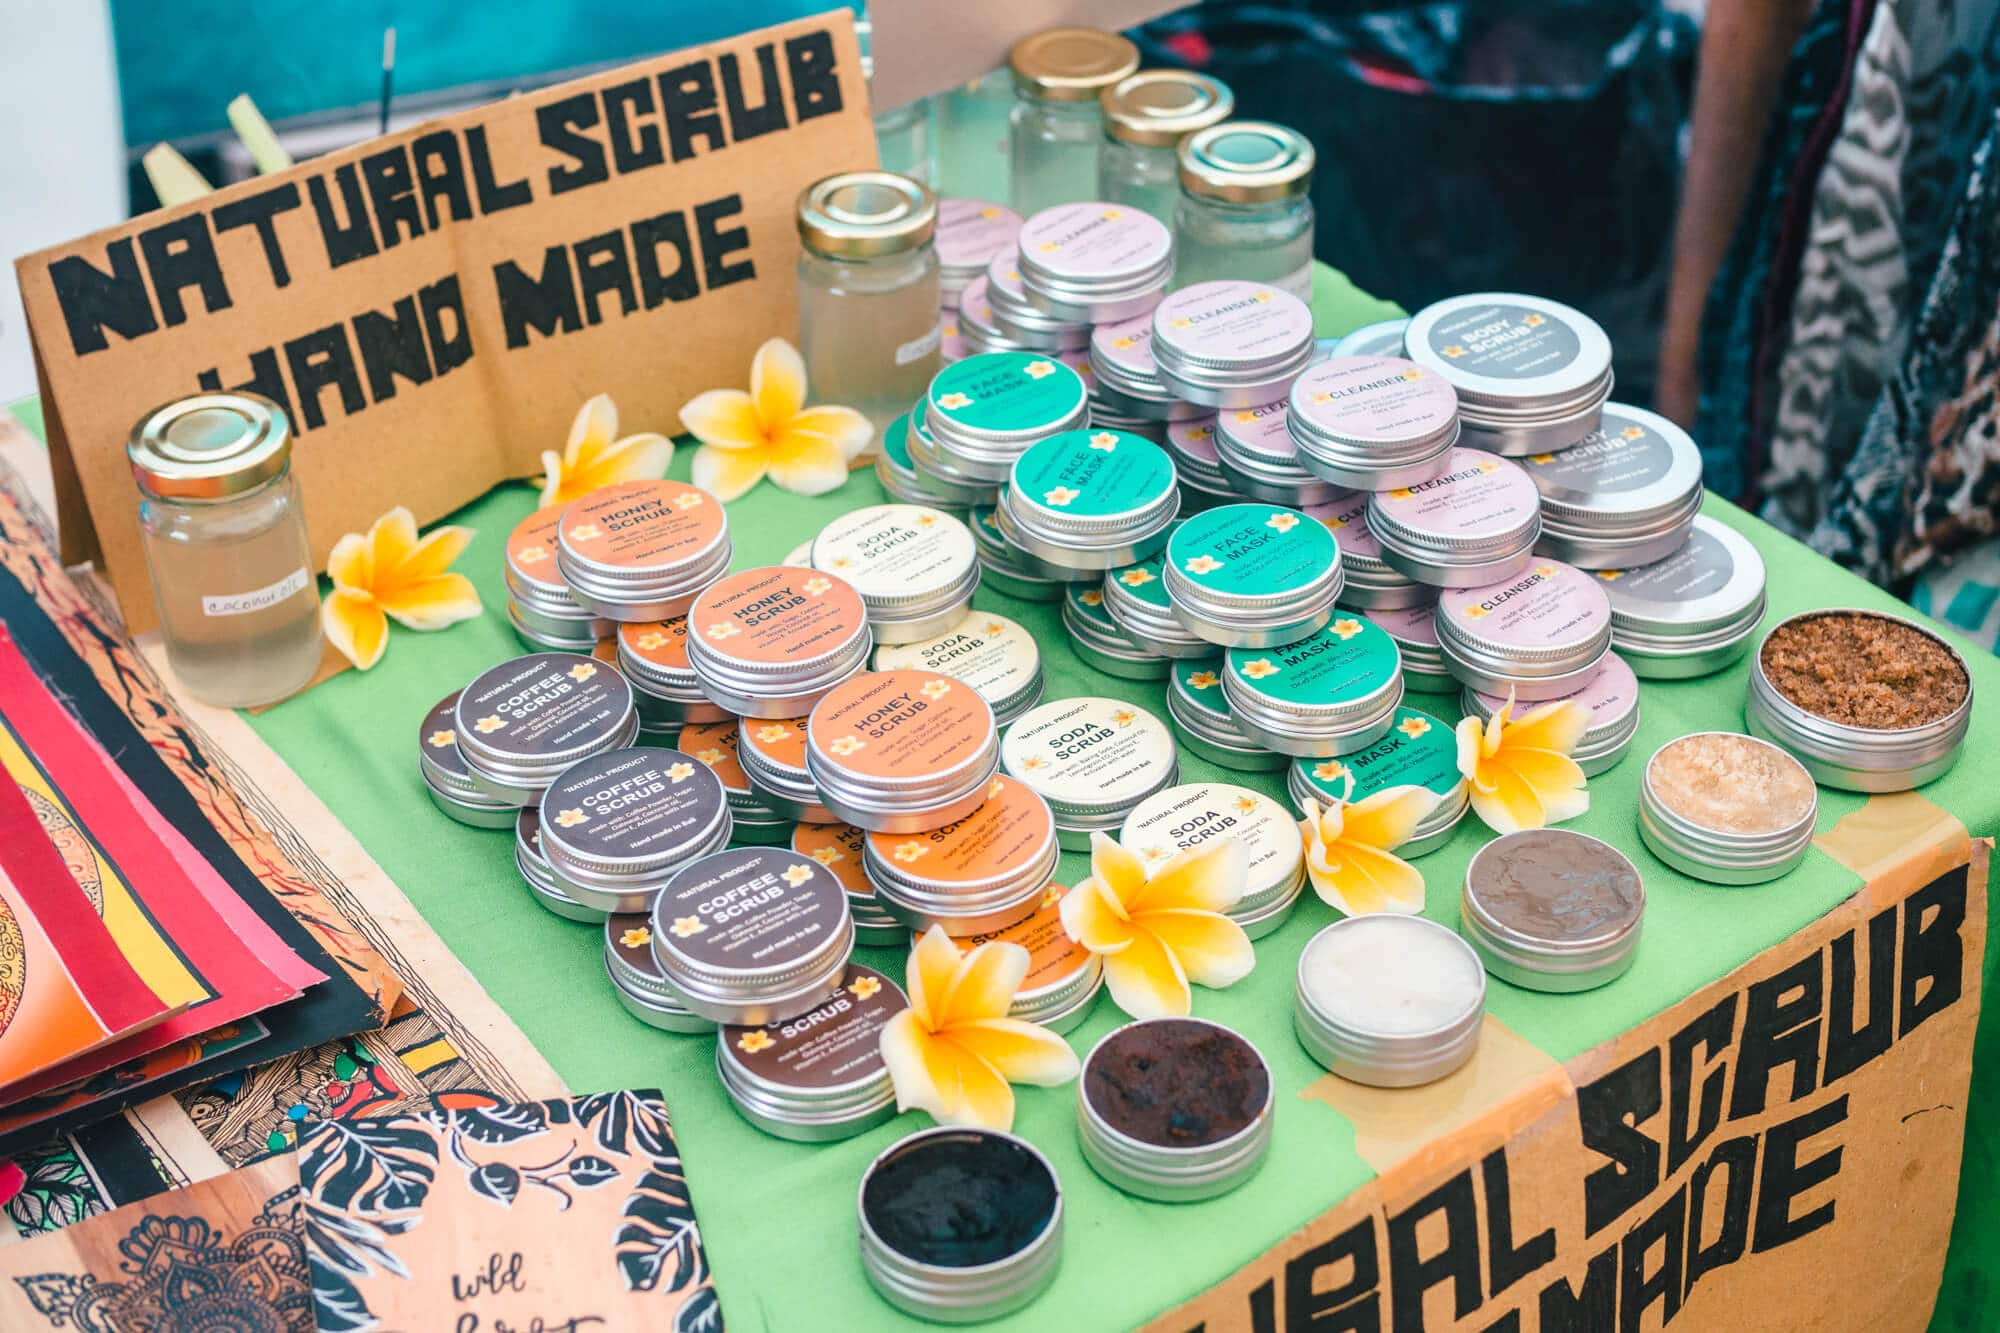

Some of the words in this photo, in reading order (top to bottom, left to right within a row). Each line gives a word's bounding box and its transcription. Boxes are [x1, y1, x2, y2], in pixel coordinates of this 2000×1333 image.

[48, 125, 533, 356] NATURAL
[535, 29, 843, 196] SCRUB
[198, 273, 476, 437] HAND
[493, 193, 756, 349] MADE
[1461, 319, 1511, 343] BODY
[1469, 326, 1531, 353] SCRUB
[970, 372, 1014, 392] FACE
[978, 378, 1029, 400] MASK
[1330, 375, 1407, 400] CLEANSER
[1561, 438, 1627, 462] SCRUB
[1060, 452, 1090, 481] FACE
[1076, 454, 1108, 486] MASK
[1408, 467, 1484, 494] CLEANSER
[601, 498, 663, 523] HONEY
[609, 507, 672, 531] SCRUB
[857, 526, 904, 549] SODA
[863, 529, 918, 559] SCRUB
[1214, 526, 1259, 551] FACE
[1225, 532, 1277, 561] MASK
[733, 586, 793, 619] HONEY
[1481, 574, 1545, 611] CLEANSER
[745, 596, 807, 627] SCRUB
[804, 634, 823, 645] made
[921, 633, 969, 658] SODA
[927, 639, 985, 668] SCRUB
[1284, 638, 1337, 667] MASK
[474, 683, 512, 703] "NATURAL
[512, 661, 548, 683] PRODUCT"
[496, 673, 565, 713] COFFEE
[512, 683, 572, 719] SCRUB
[854, 692, 912, 731] HONEY
[553, 731, 572, 744] Hand
[572, 722, 591, 734] made
[597, 710, 611, 719] Bali
[869, 700, 928, 739] SCRUB
[1018, 722, 1055, 741] "NATURAL
[1054, 703, 1089, 723] PRODUCT"
[1049, 722, 1099, 749] SODA
[1055, 728, 1115, 760] SCRUB
[1354, 738, 1407, 768] MASK
[563, 774, 606, 793] "NATURAL
[606, 755, 648, 776] PRODUCT"
[582, 770, 661, 807] COFFEE
[1099, 778, 1116, 789] Hand
[1115, 770, 1132, 780] made
[1139, 760, 1152, 768] Bali
[596, 782, 665, 815] SCRUB
[1137, 810, 1174, 829] "NATURAL
[1173, 789, 1209, 812] PRODUCT"
[630, 836, 651, 849] Hand
[651, 827, 672, 839] made
[672, 823, 681, 831] in
[681, 817, 696, 826] Bali
[1169, 810, 1220, 839] SODA
[1177, 816, 1238, 850] SCRUB
[676, 878, 721, 899] "NATURAL
[719, 857, 763, 881] PRODUCT"
[698, 872, 779, 914] COFFEE
[713, 886, 784, 923] SCRUB
[774, 935, 796, 948] made
[781, 998, 852, 1039] SCRUB
[1576, 863, 1970, 1239] SCRUB
[452, 1253, 526, 1301] wild
